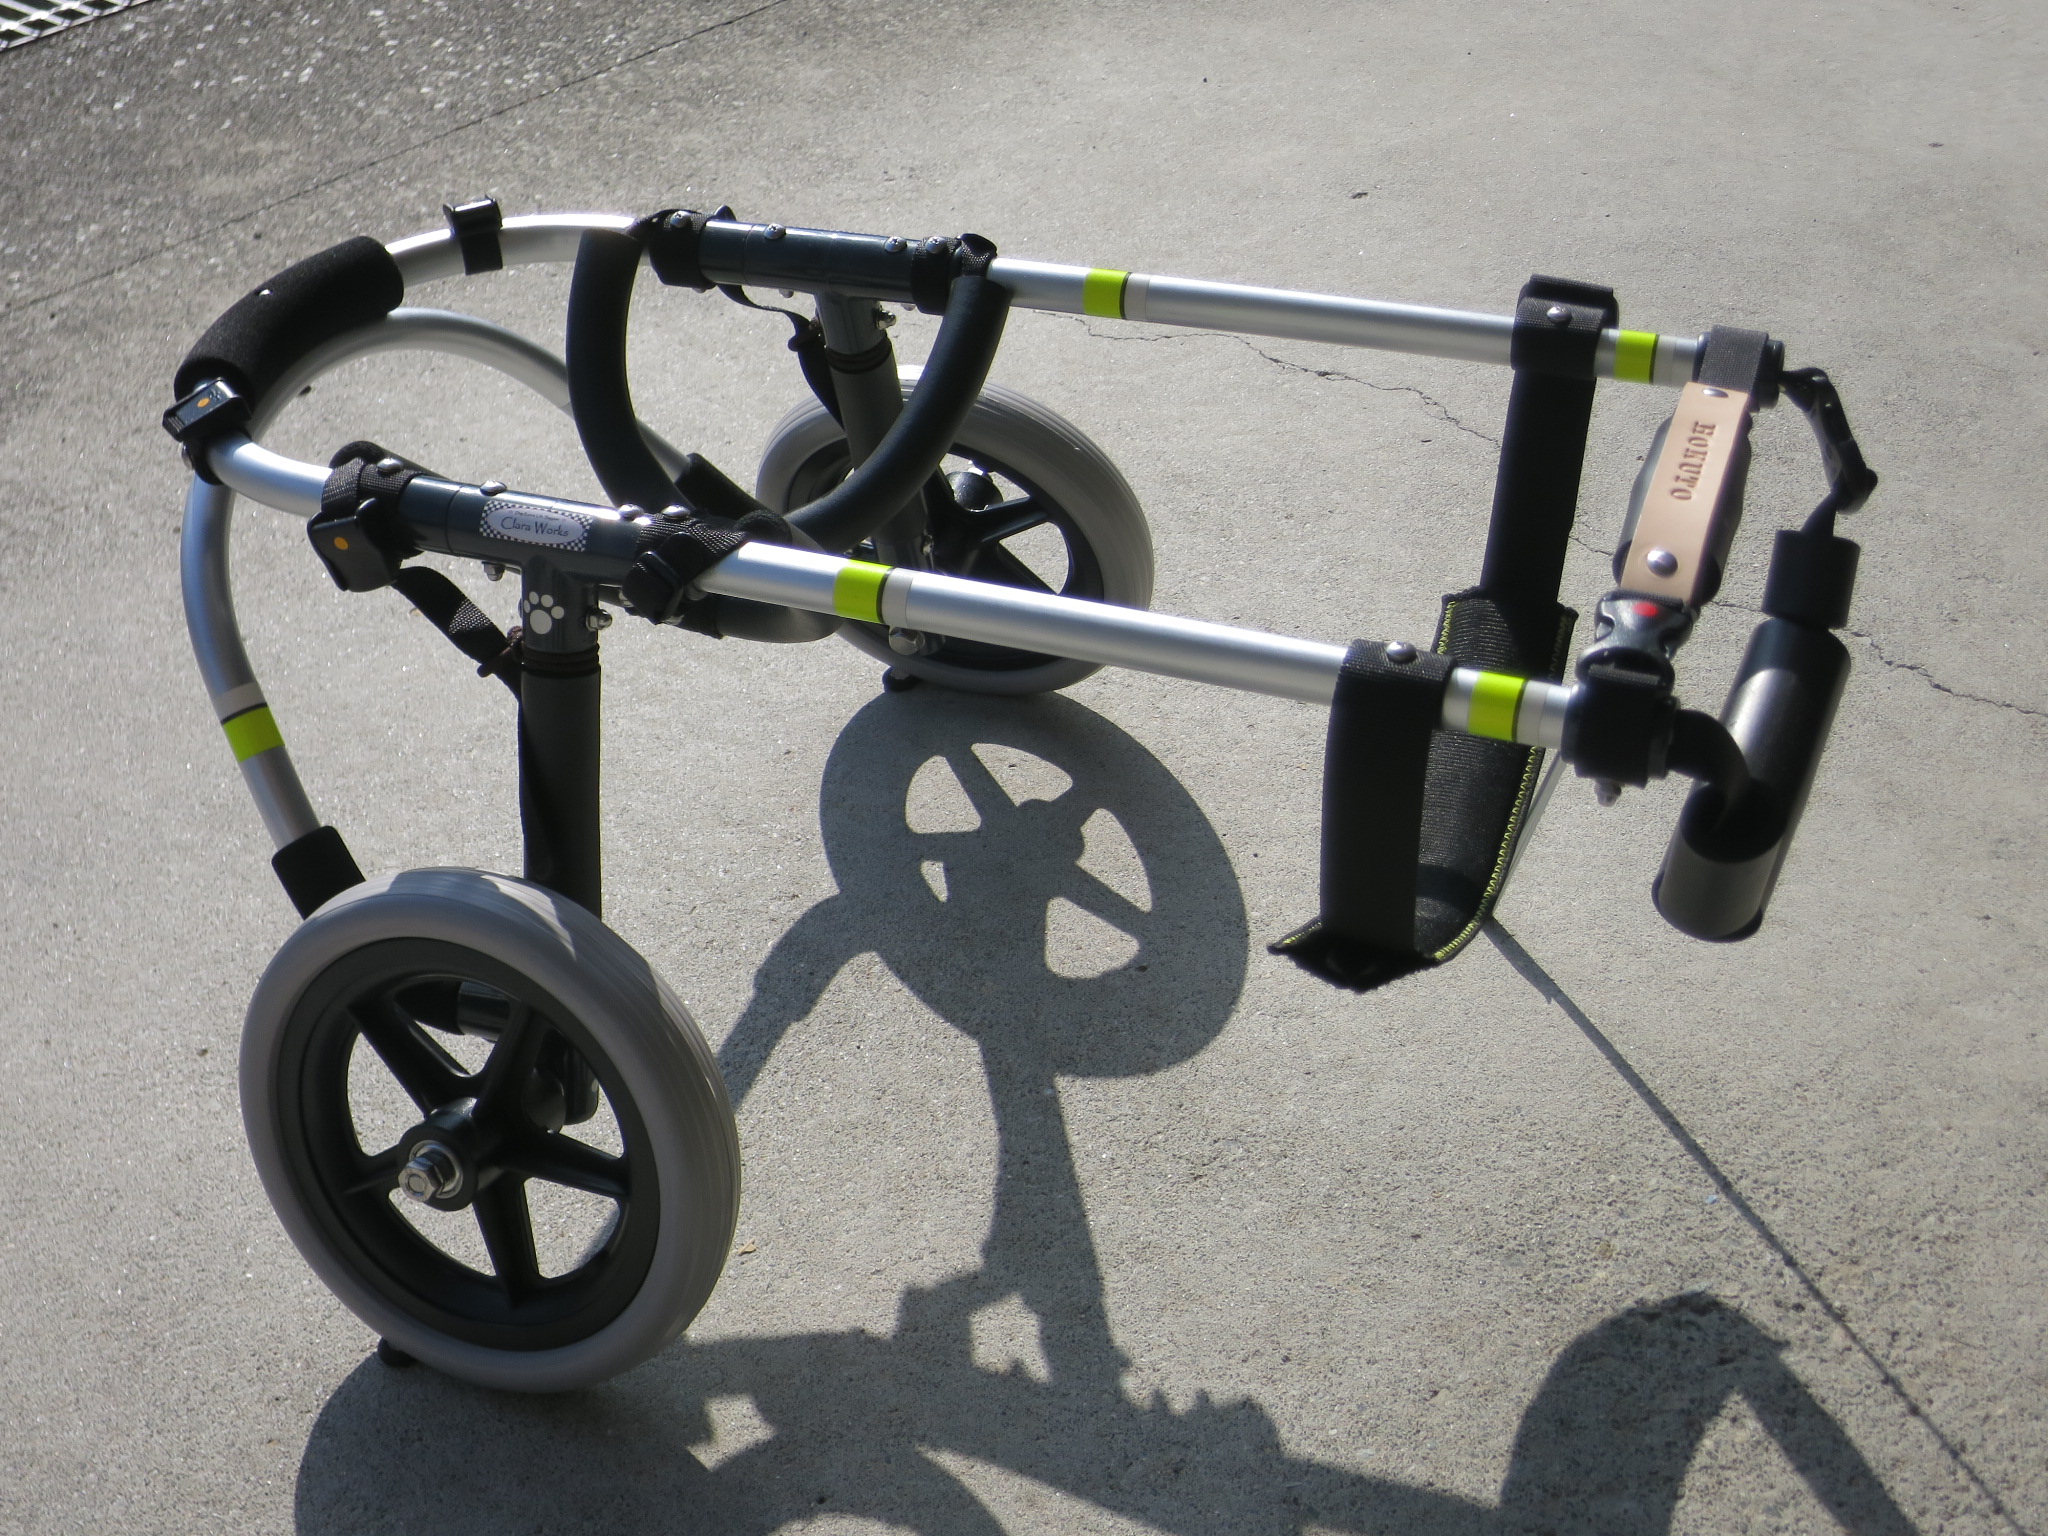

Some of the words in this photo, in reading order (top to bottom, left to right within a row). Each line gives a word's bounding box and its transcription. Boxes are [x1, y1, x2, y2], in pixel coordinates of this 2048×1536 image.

[1670, 421, 1716, 501] HOKUTO
[500, 516, 531, 531] Clara
[534, 521, 569, 537] Works
